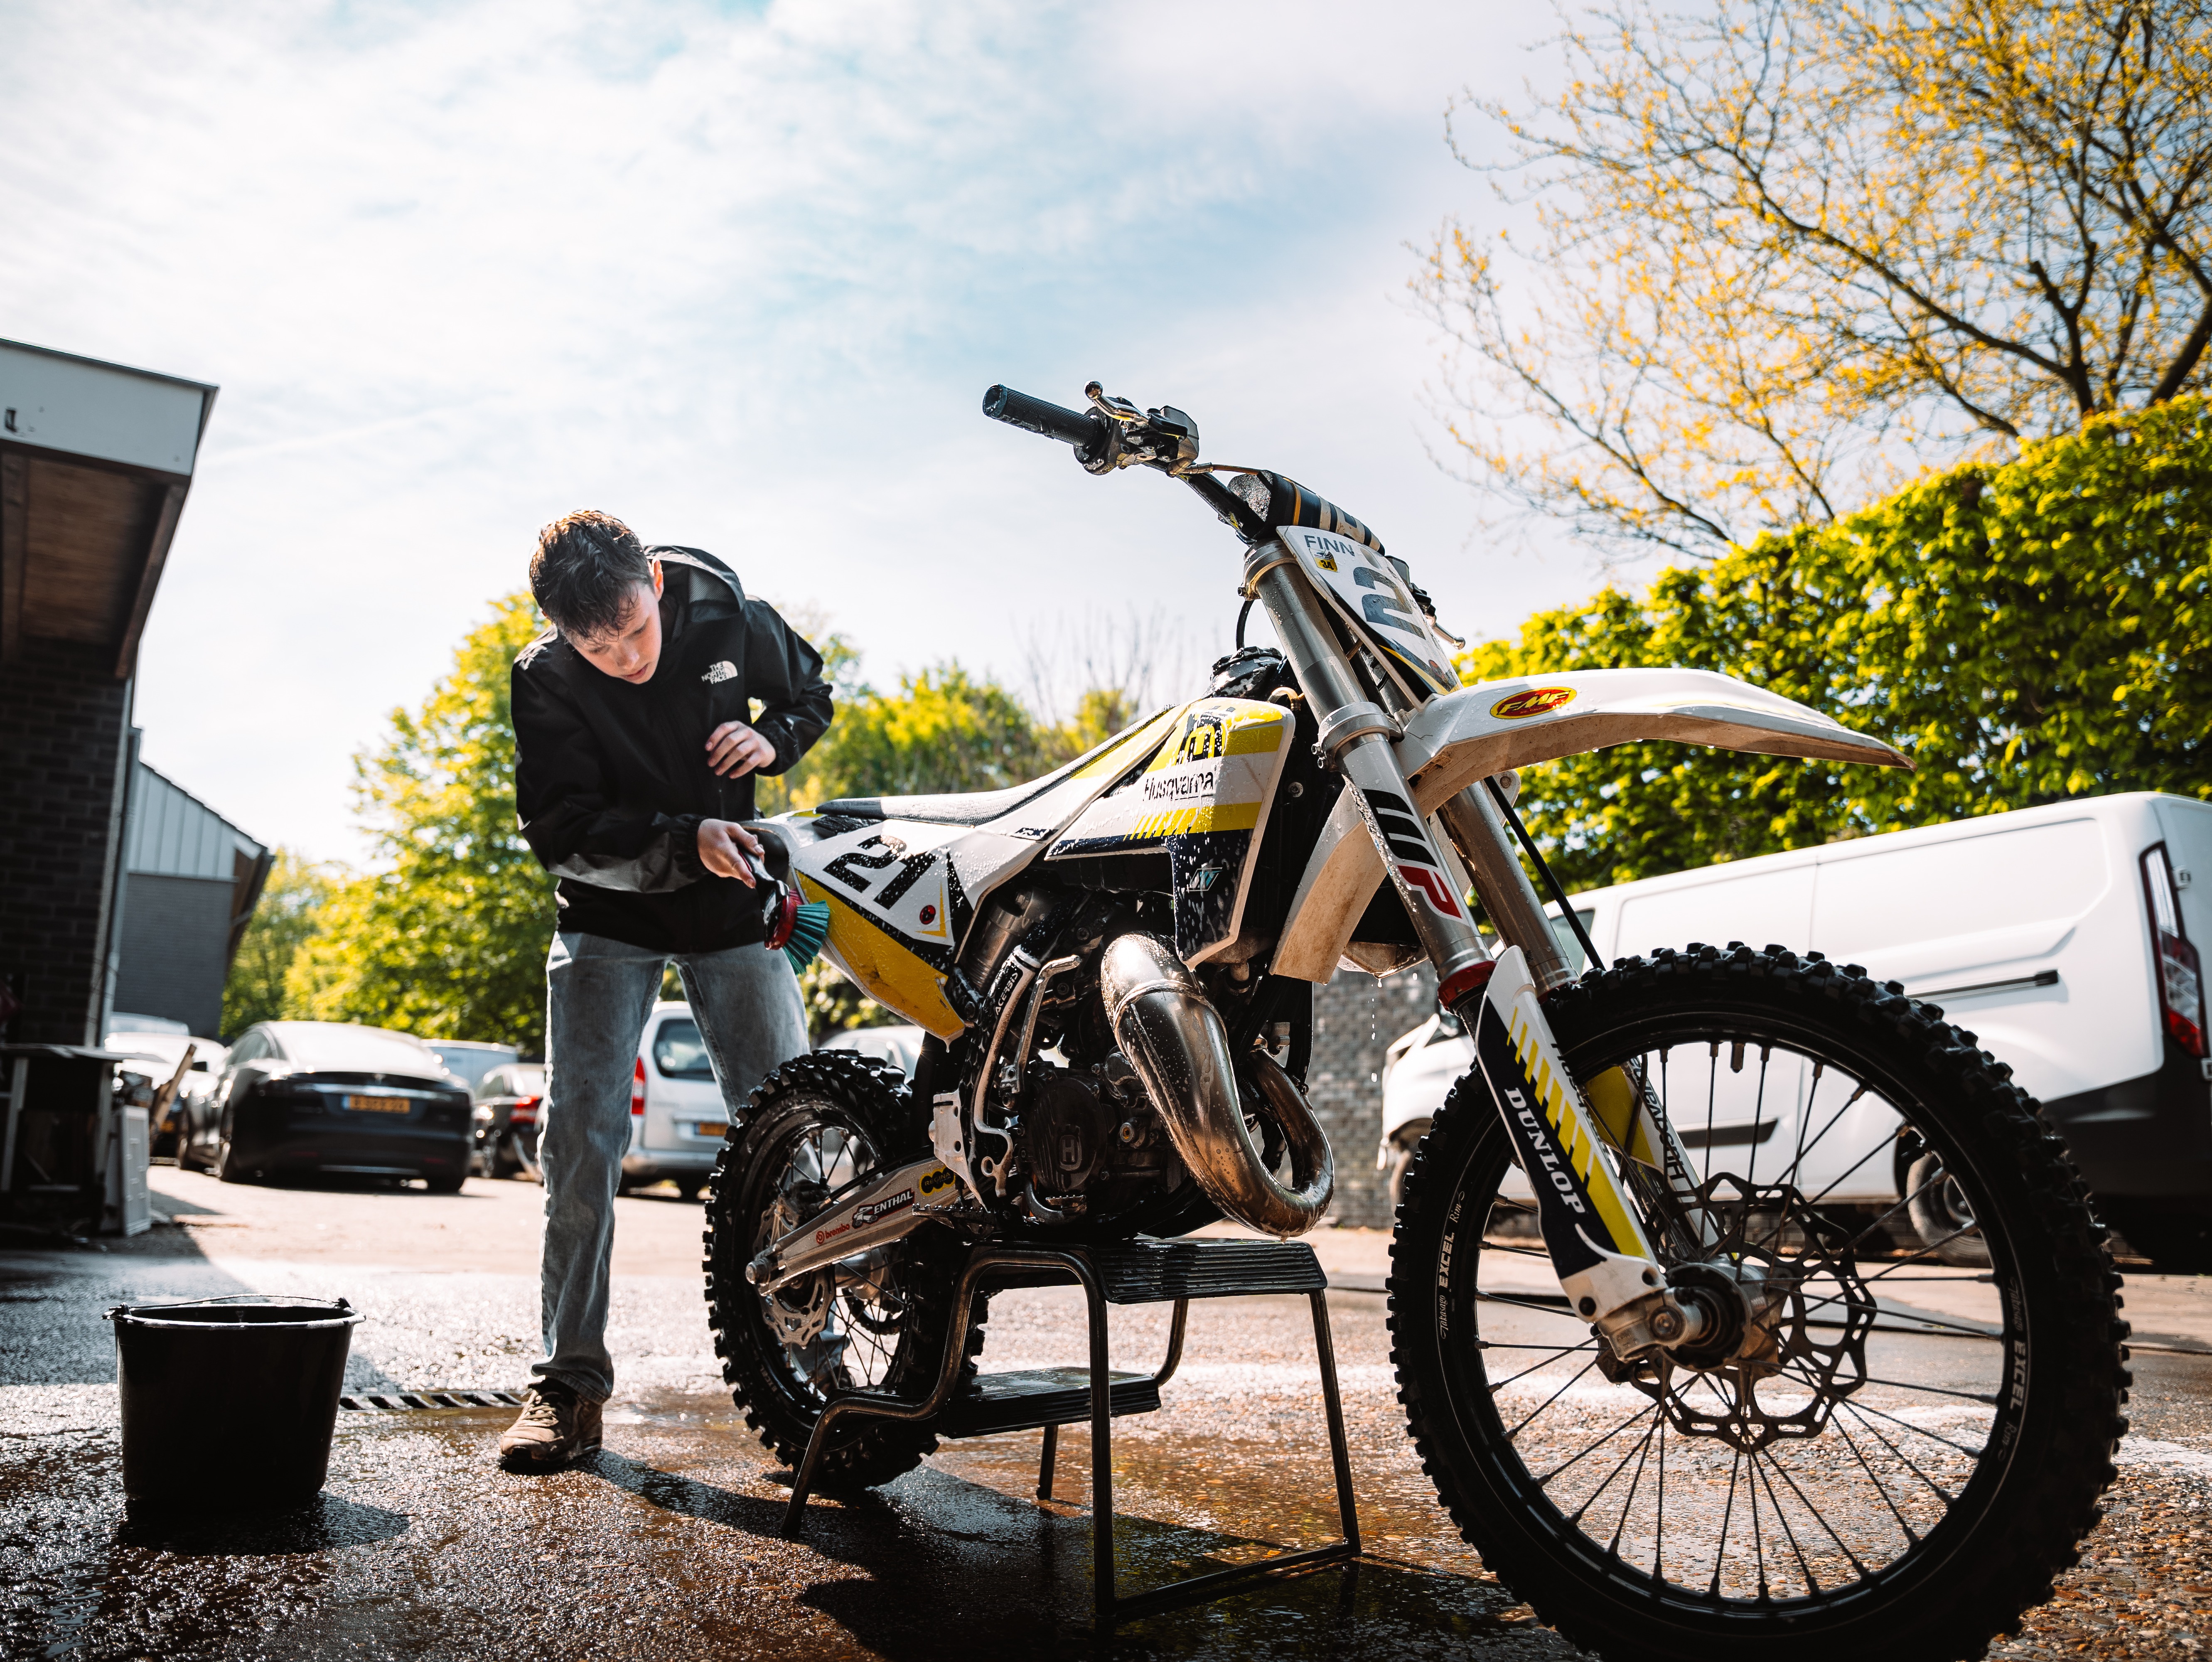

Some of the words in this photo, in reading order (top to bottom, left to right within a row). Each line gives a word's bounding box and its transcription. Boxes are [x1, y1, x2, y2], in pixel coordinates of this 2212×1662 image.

[1304, 535, 1355, 557] FINN
[701, 669, 726, 682] NORTH
[709, 662, 723, 672] THE
[710, 675, 727, 685] FACE
[1496, 690, 1571, 715] FMF
[1143, 771, 1214, 801] Husqvarna
[1361, 788, 1462, 919] WP
[1504, 1087, 1585, 1213] DUNLOP
[924, 1172, 951, 1186] REGINA
[1449, 1190, 1465, 1223] Rim
[825, 1223, 850, 1239] brembo
[1438, 1232, 1455, 1288] EXCEL
[1439, 1295, 1449, 1339] Takasago
[2010, 1340, 2026, 1410] EXCEL
